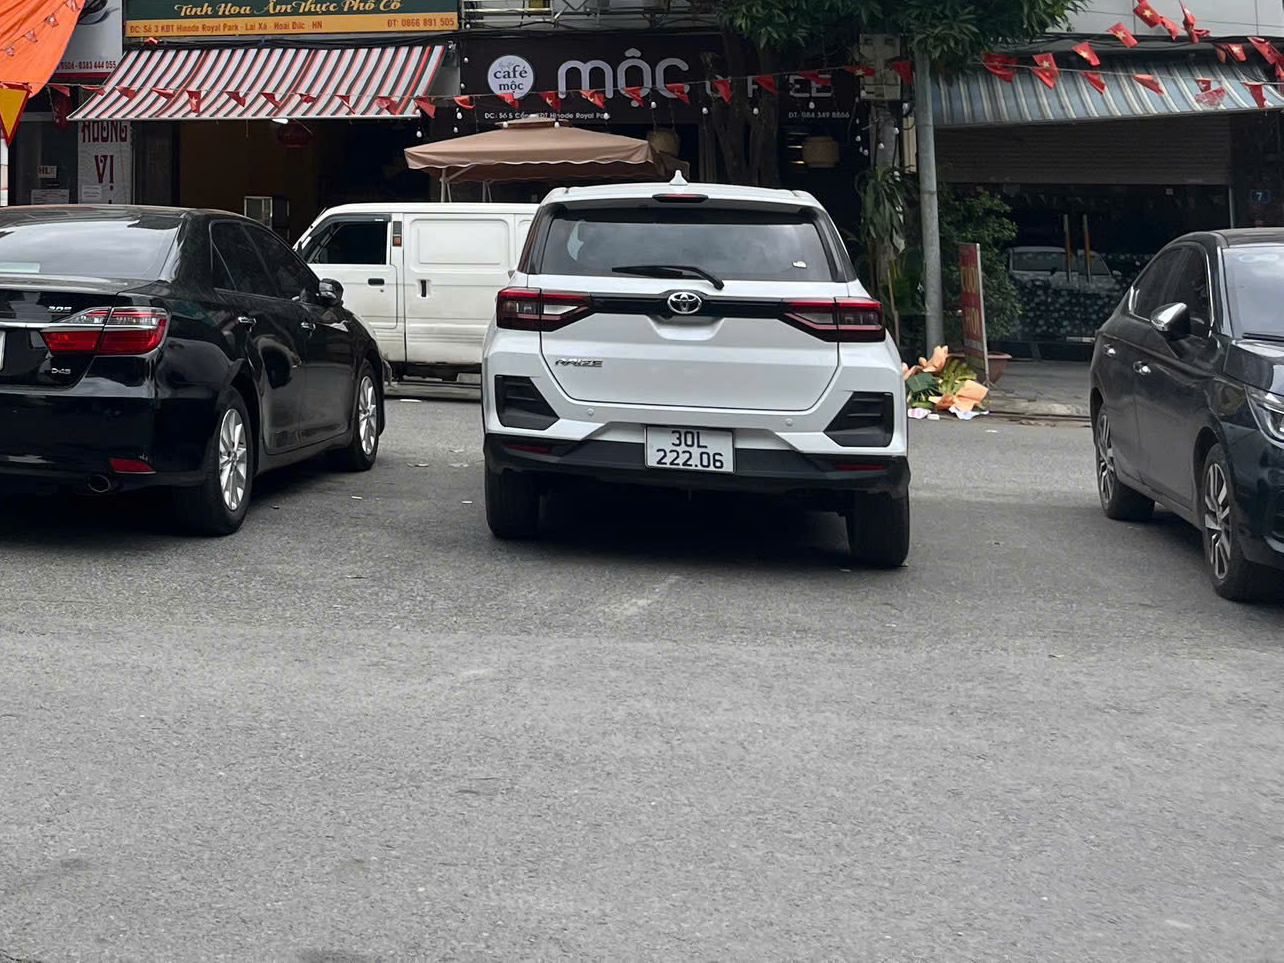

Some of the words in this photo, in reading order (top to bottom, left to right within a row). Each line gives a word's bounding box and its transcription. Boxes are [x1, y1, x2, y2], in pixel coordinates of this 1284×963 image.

[174, 3, 214, 17] Tinh
[217, 3, 252, 16] Hoa
[202, 23, 221, 34] Royal
[223, 22, 239, 32] Park
[312, 20, 323, 29] HN
[401, 18, 421, 27] 0866
[423, 18, 437, 27] 891
[440, 17, 454, 26] 505
[94, 61, 105, 69] 444
[106, 60, 117, 69] 055
[493, 64, 528, 79] café
[499, 80, 524, 93] mộc
[576, 112, 594, 120] Royal
[94, 154, 115, 191] VỊ
[671, 430, 708, 449] 30L
[656, 448, 724, 469] 222.06
